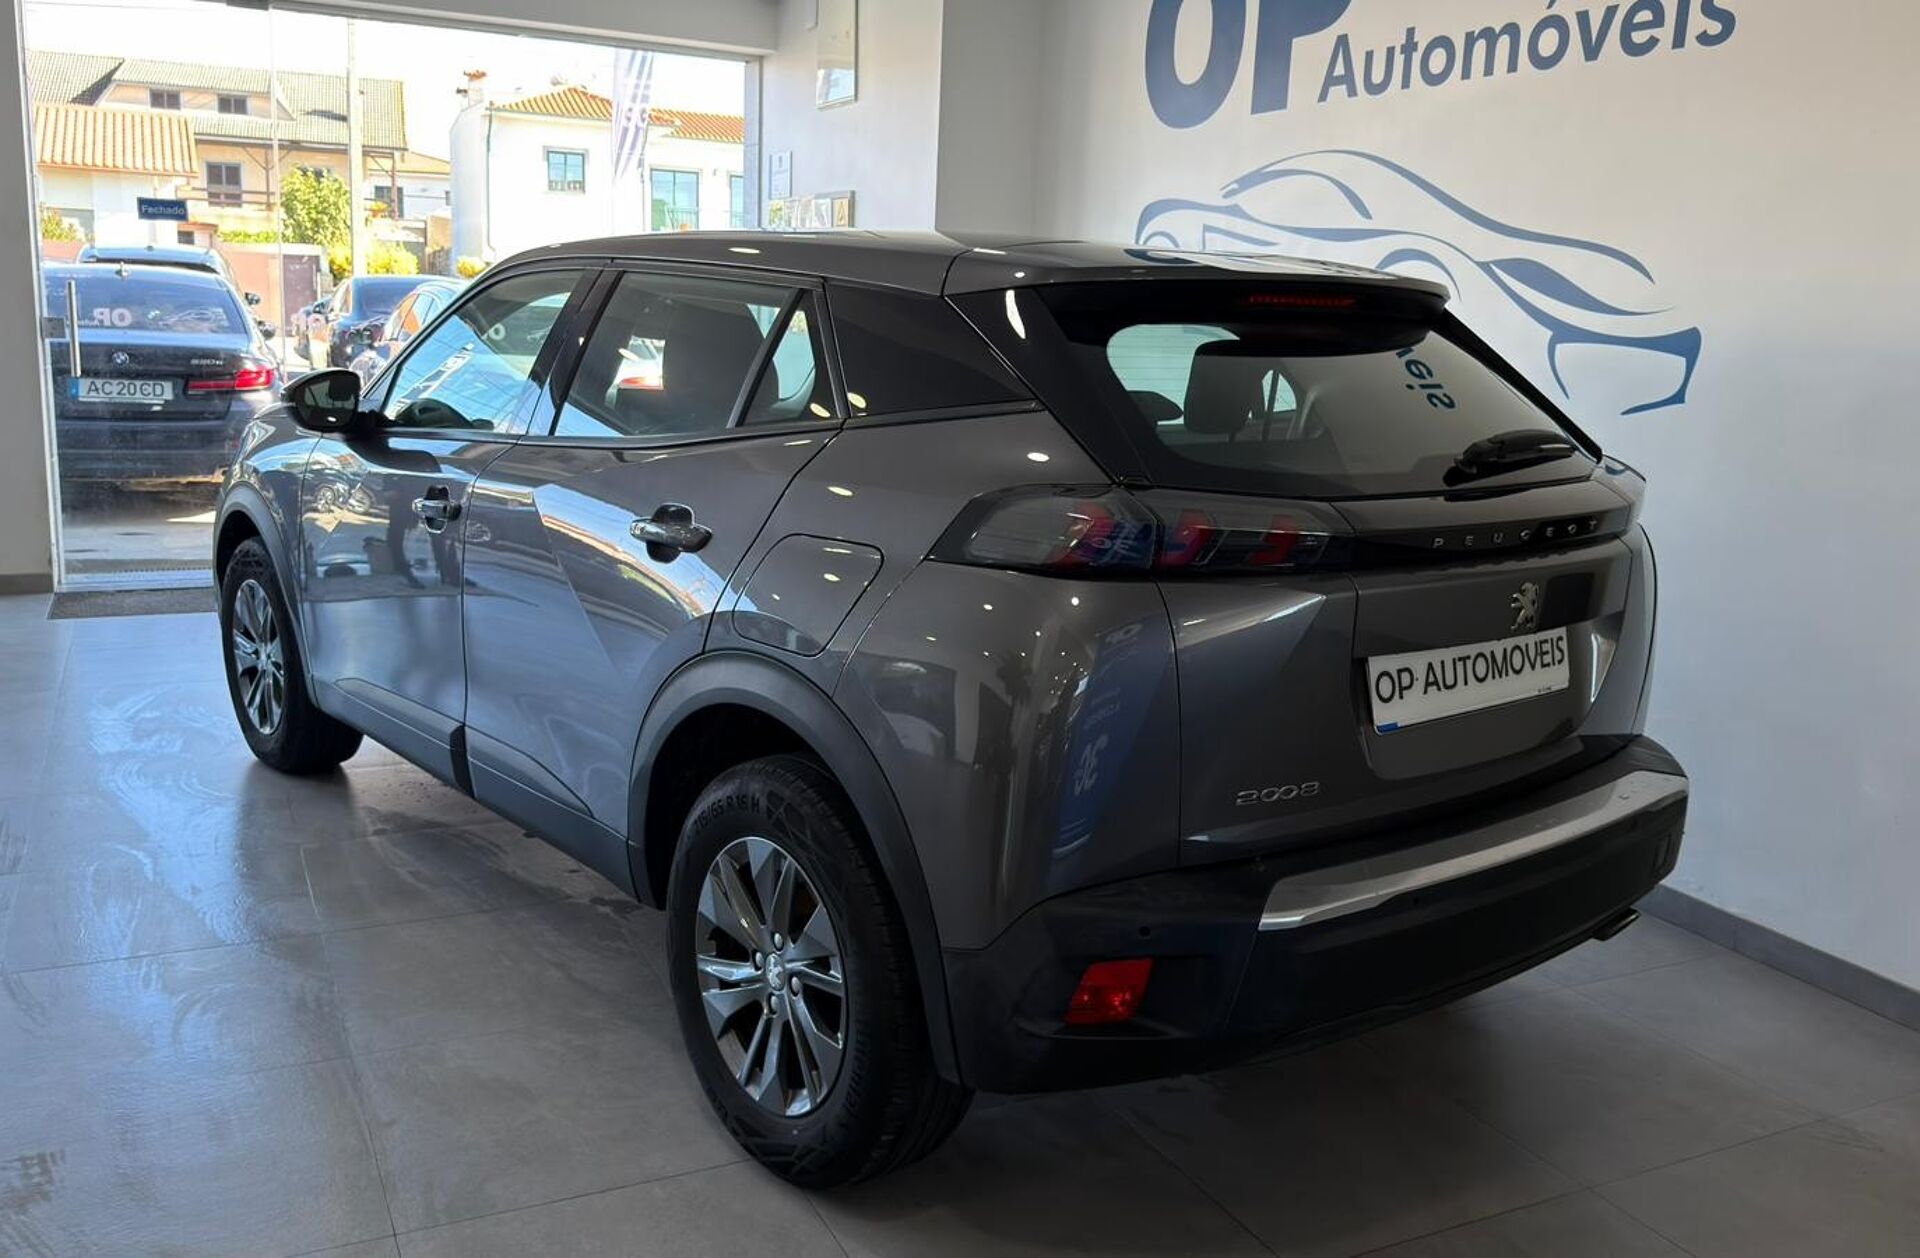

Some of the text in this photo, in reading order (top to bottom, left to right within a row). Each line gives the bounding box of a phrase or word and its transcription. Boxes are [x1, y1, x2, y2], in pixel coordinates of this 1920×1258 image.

[1145, 0, 1352, 129] OP
[141, 204, 185, 215] Fechado
[1432, 520, 1597, 549] PEUGEOT
[1375, 635, 1565, 704] OP AUTOMOVEIS
[1235, 781, 1320, 806] 2008
